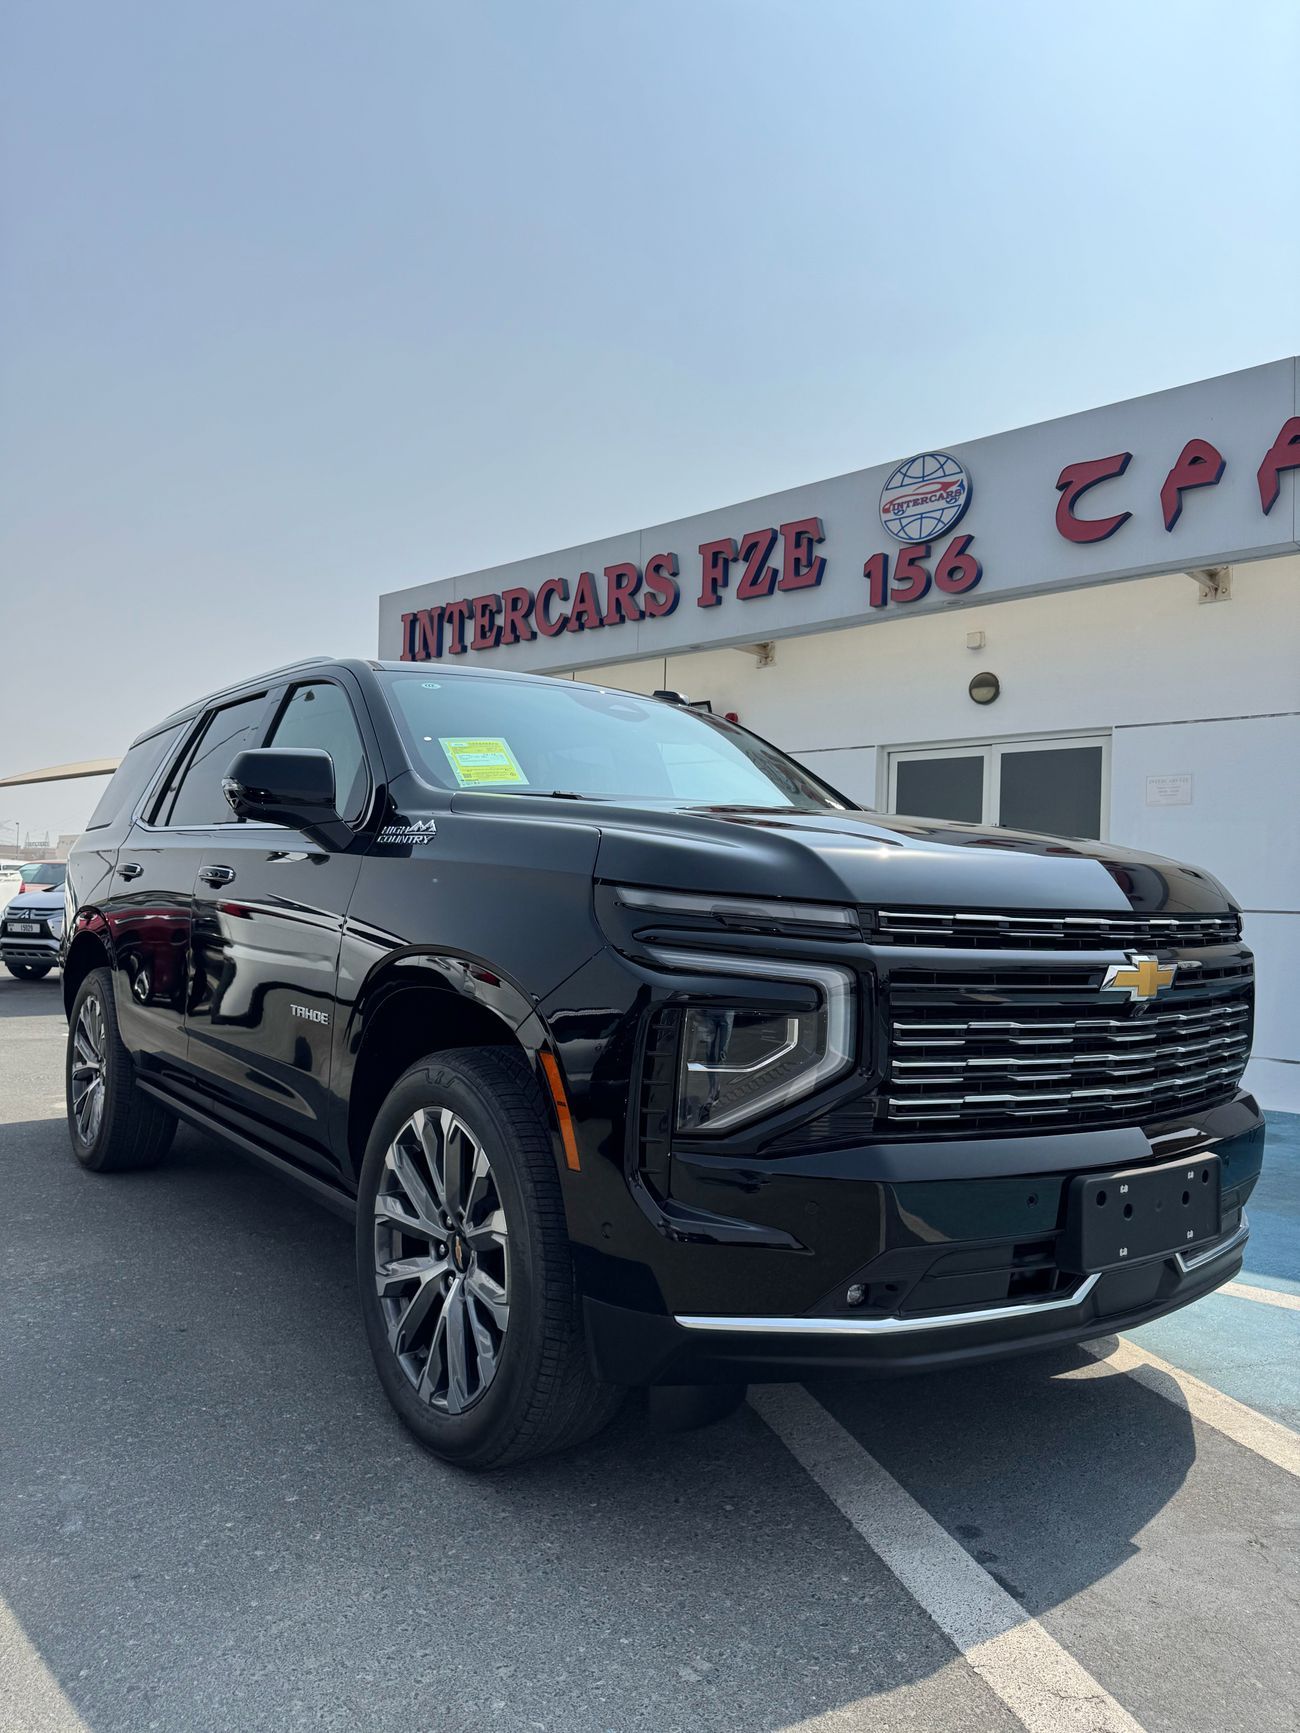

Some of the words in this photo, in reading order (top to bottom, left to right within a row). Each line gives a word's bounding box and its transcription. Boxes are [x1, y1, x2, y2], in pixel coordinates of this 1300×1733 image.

[891, 487, 962, 512] INTERCARS
[863, 533, 983, 608] 156
[400, 552, 680, 661] INTERCARS
[697, 516, 827, 608] FZE
[376, 835, 434, 845] COUNTRY
[381, 826, 411, 835] HIGH
[290, 1004, 329, 1025] TAHOE
